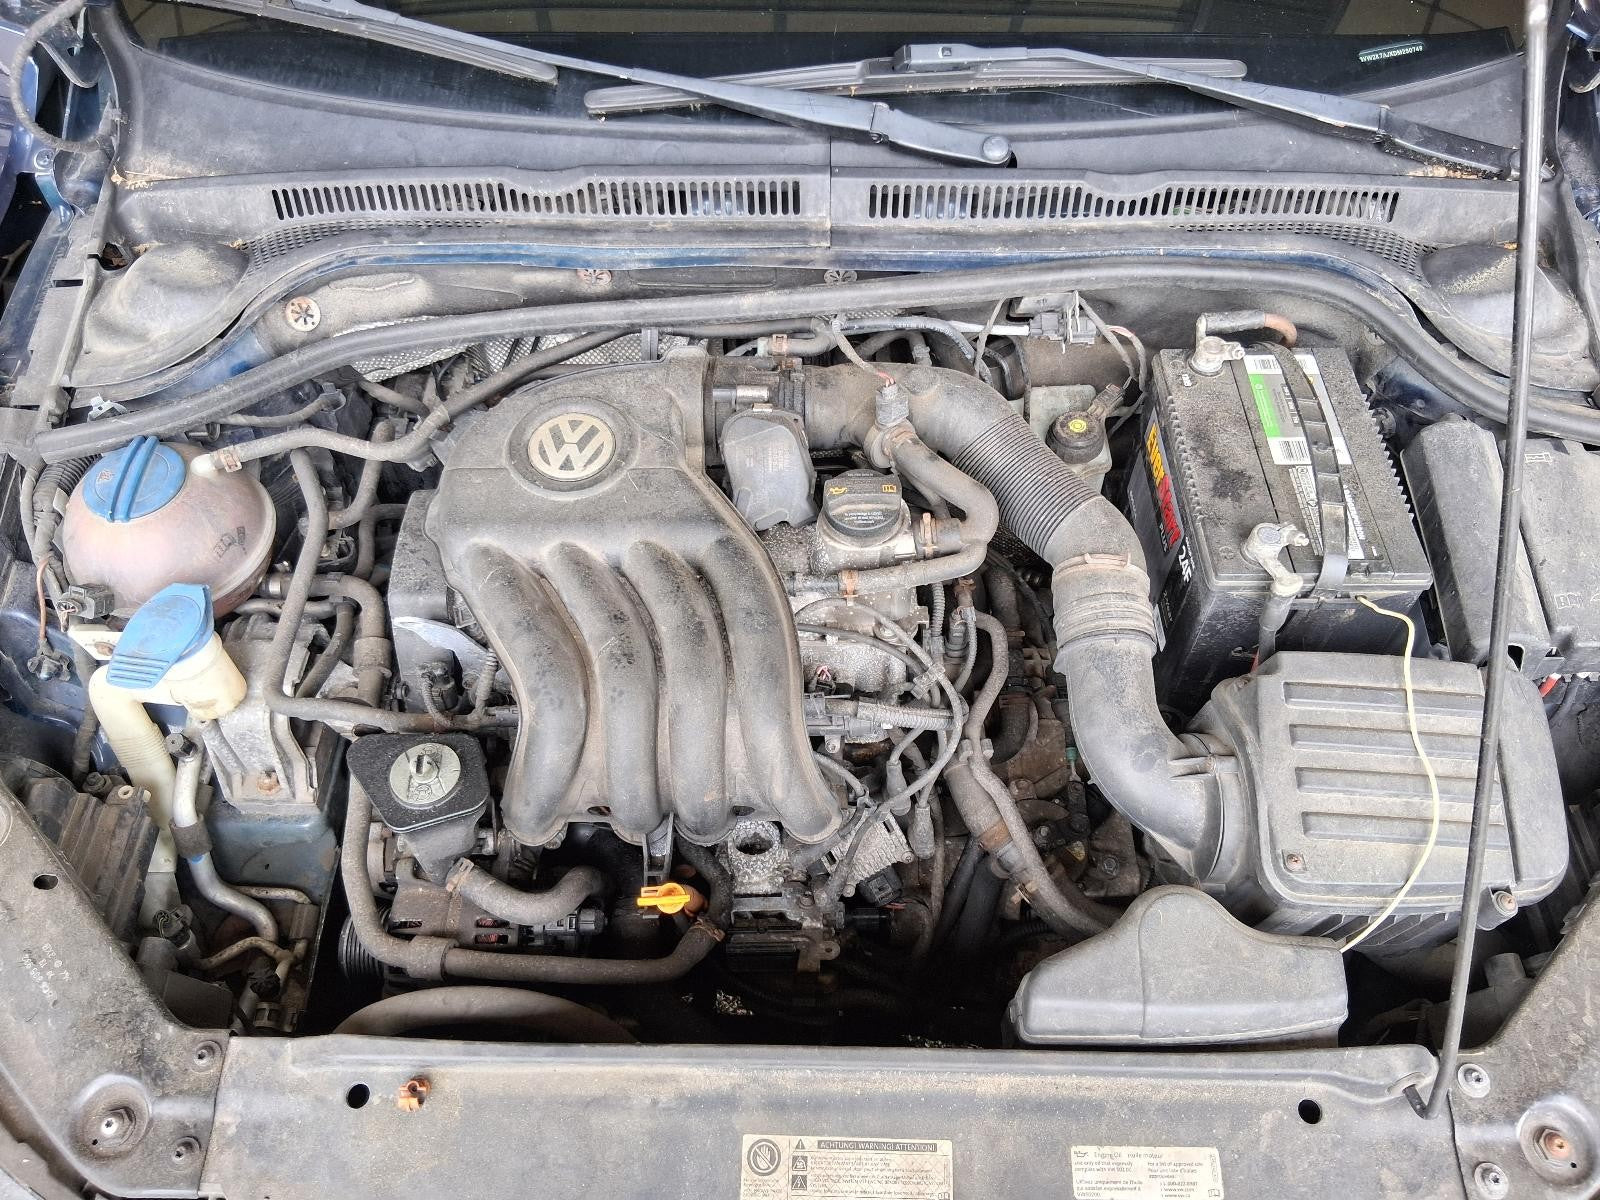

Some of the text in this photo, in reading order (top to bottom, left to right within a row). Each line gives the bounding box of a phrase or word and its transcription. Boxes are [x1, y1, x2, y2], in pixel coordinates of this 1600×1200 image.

[1159, 522, 1169, 553] PLUS
[1178, 545, 1192, 583] 24F
[820, 1141, 857, 1149] ACHTUNG!
